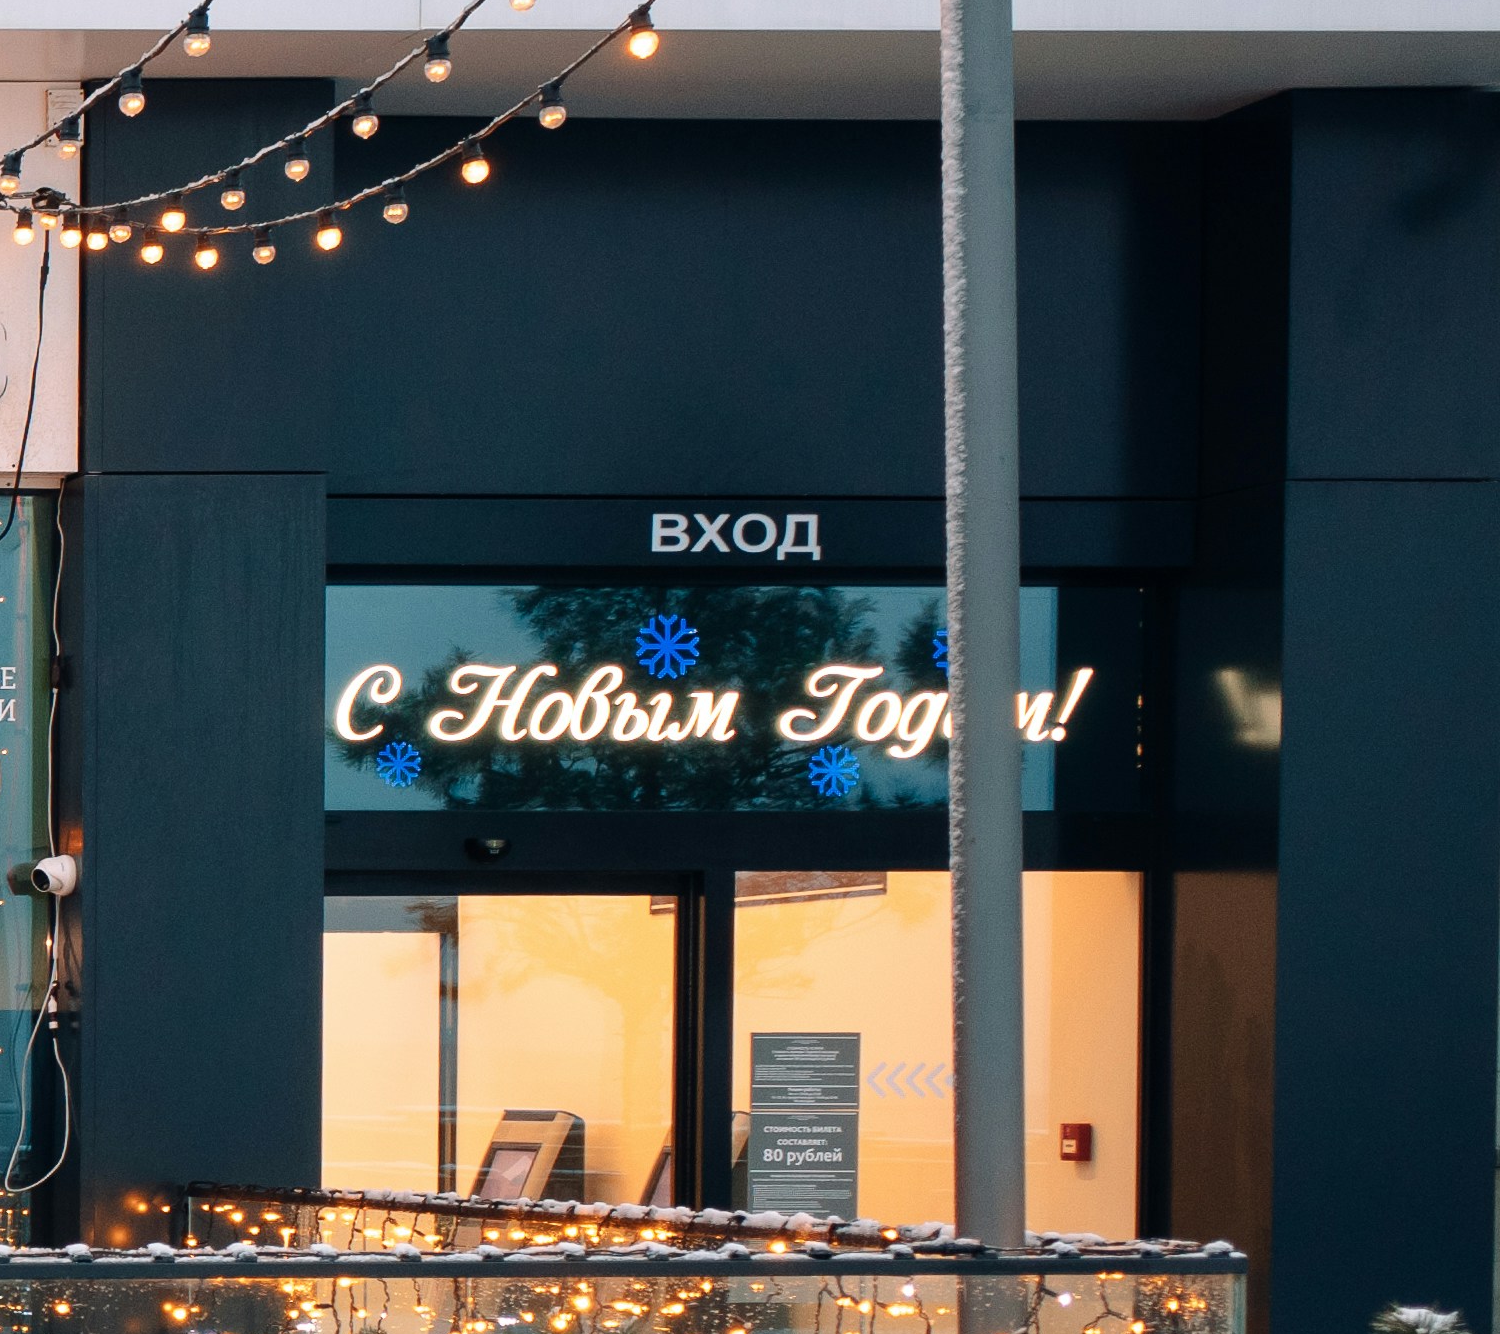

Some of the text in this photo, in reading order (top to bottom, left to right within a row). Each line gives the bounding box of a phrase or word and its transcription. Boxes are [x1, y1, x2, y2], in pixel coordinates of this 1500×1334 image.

[651, 512, 823, 561] ВХОД
[333, 663, 1094, 759] С Новым Годм!
[763, 1147, 843, 1166] 80 рублей
